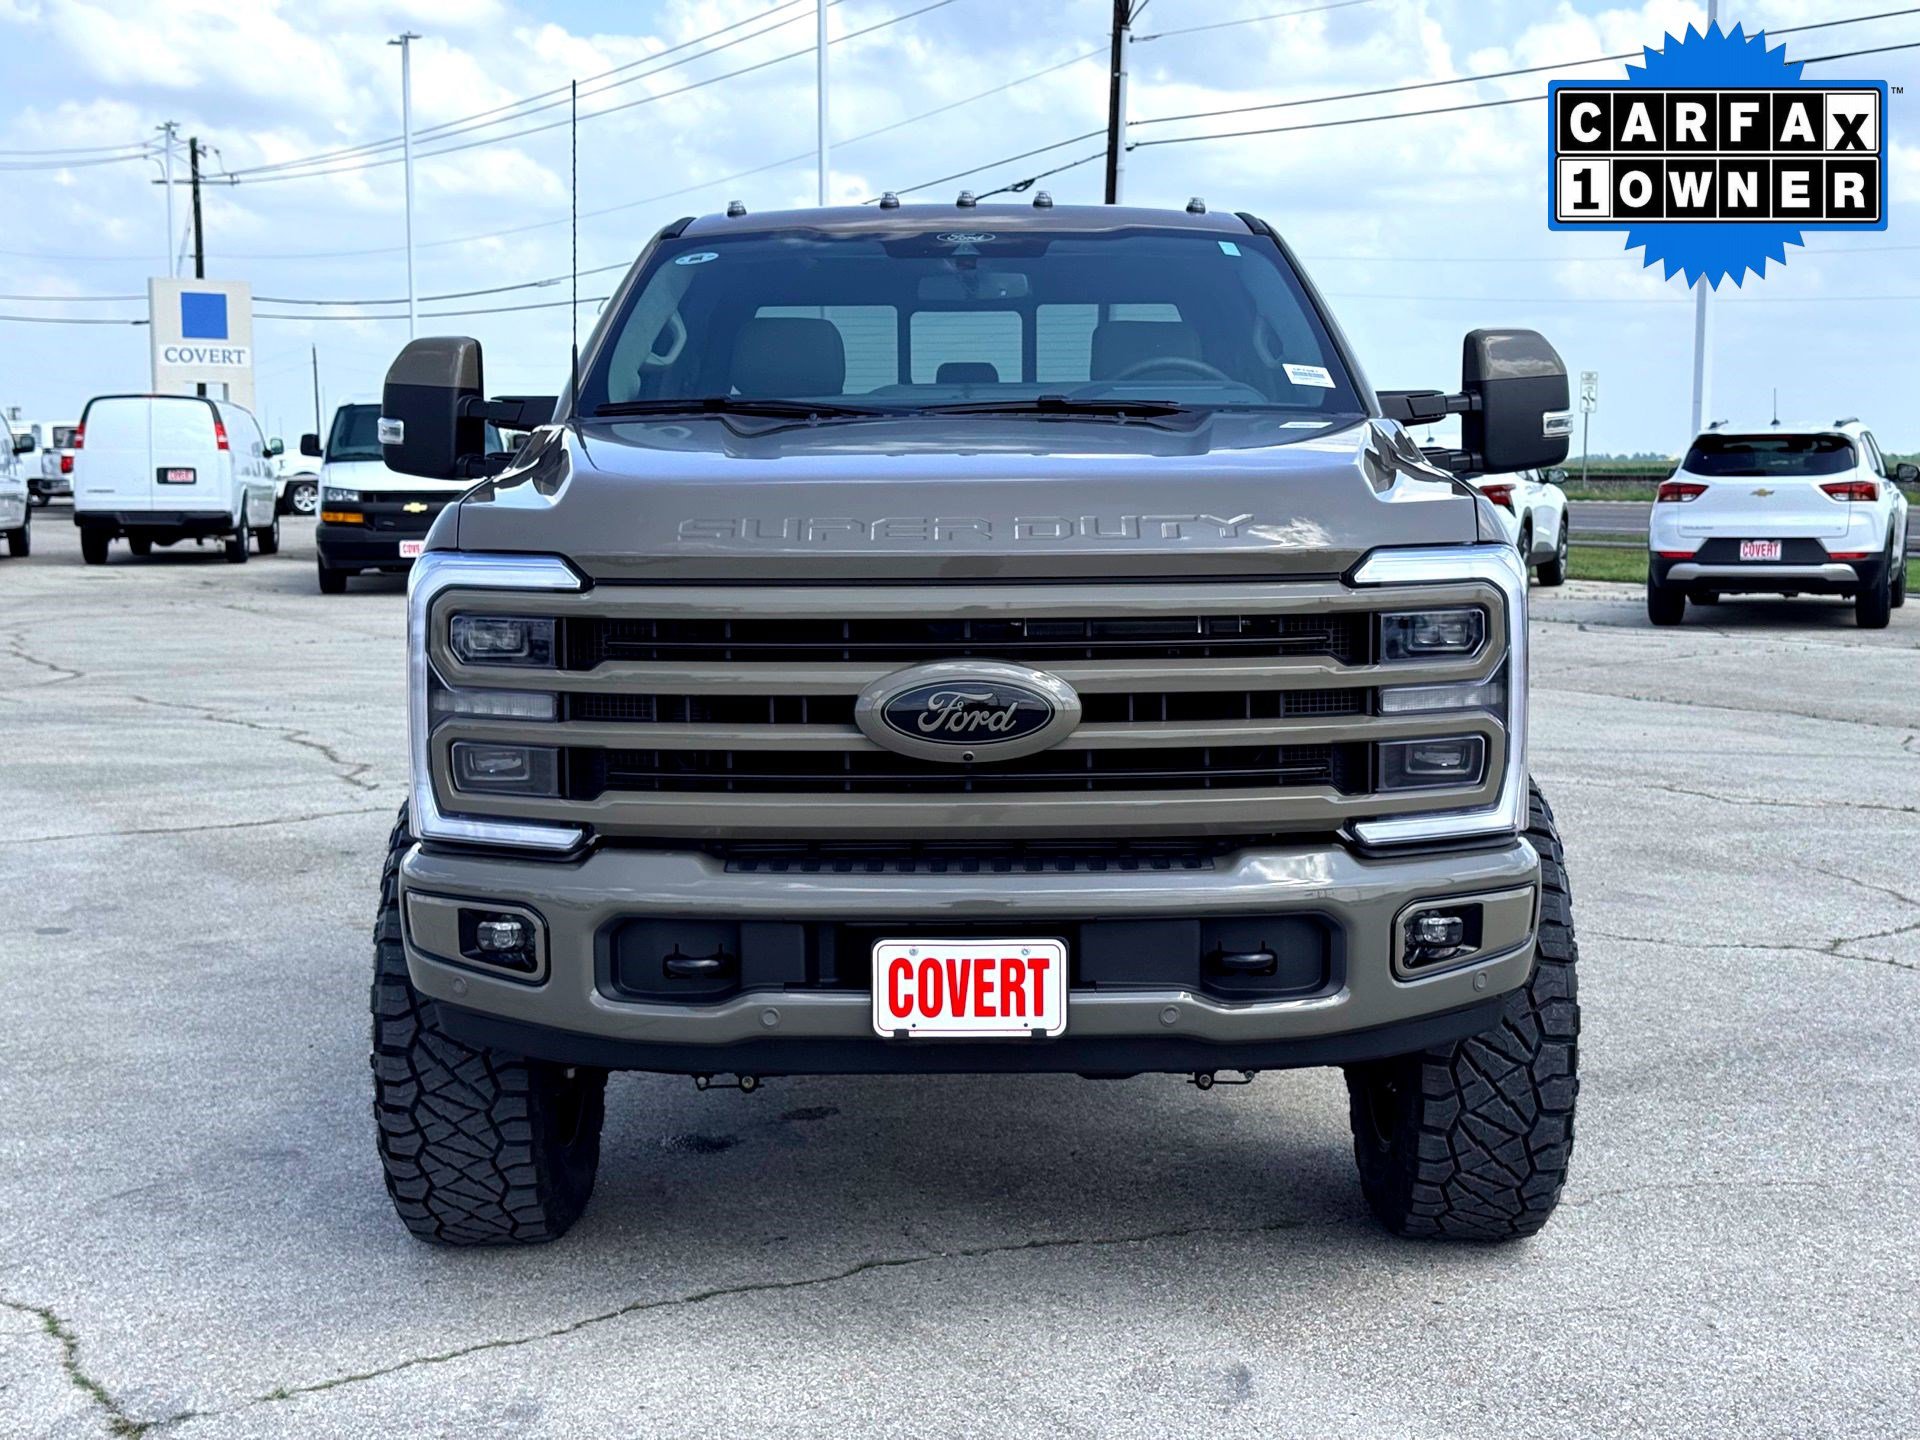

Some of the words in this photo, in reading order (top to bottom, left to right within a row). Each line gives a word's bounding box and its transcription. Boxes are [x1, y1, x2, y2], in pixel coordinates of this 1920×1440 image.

[946, 232, 985, 241] Ford
[164, 346, 246, 365] COVERT
[677, 516, 993, 541] SUPER
[1013, 513, 1256, 541] DUTY
[1742, 542, 1780, 558] COVERT
[917, 691, 1019, 732] Ford
[888, 957, 1050, 1018] COVERT
